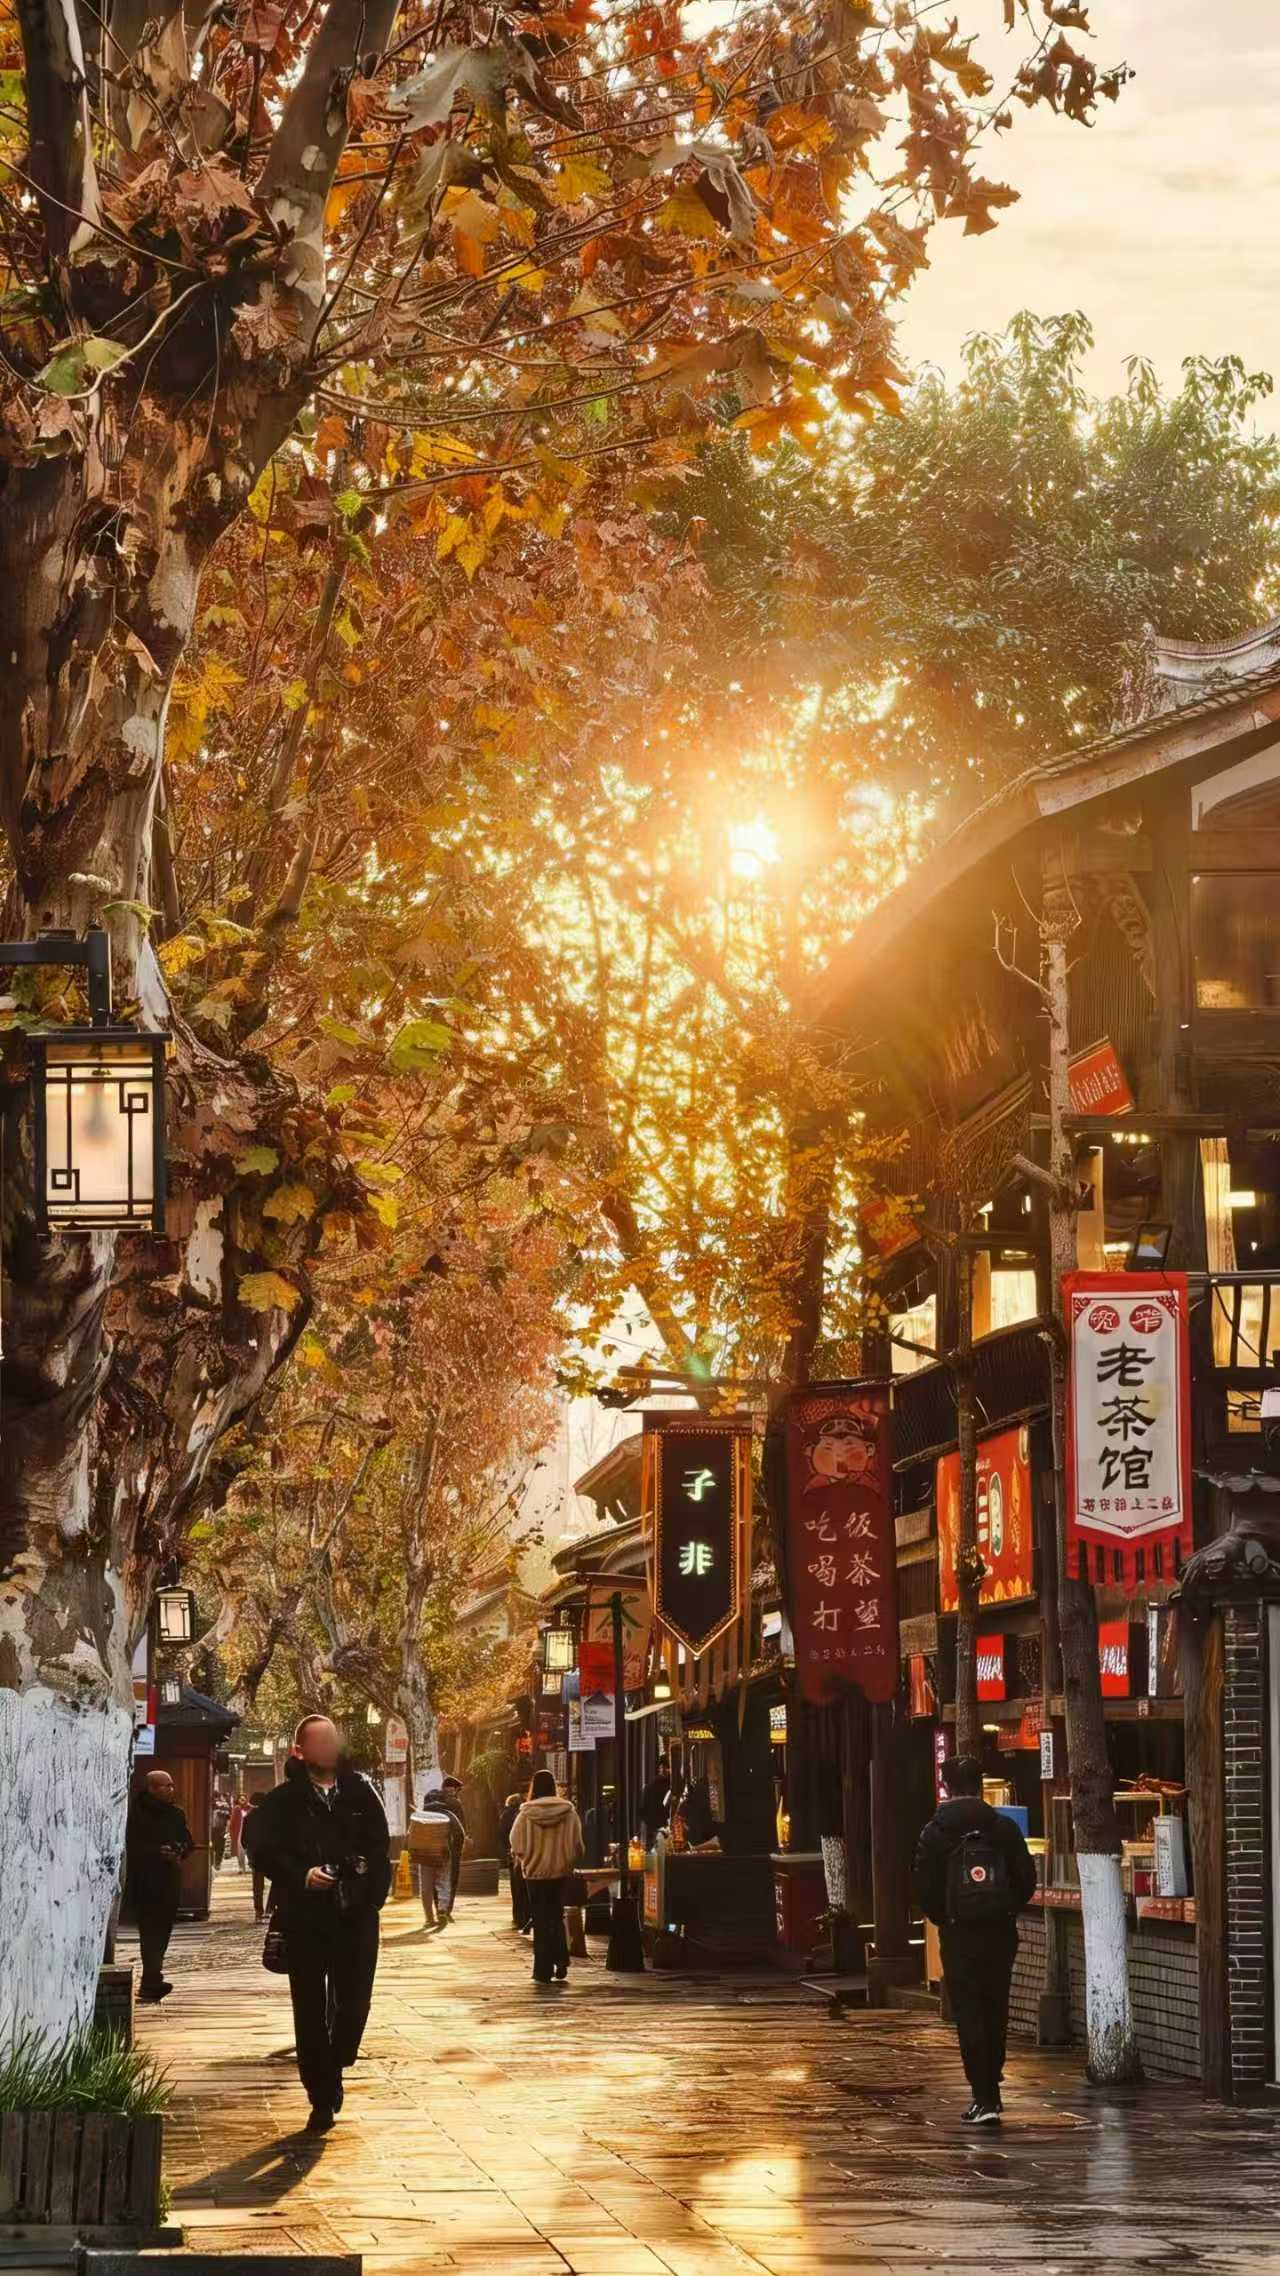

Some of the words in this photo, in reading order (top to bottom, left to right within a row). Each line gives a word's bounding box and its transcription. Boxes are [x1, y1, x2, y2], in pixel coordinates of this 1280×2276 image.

[1097, 1341, 1156, 1491] 老茶馆
[679, 1468, 716, 1576] 子非
[807, 1549, 880, 1587] 喝茶
